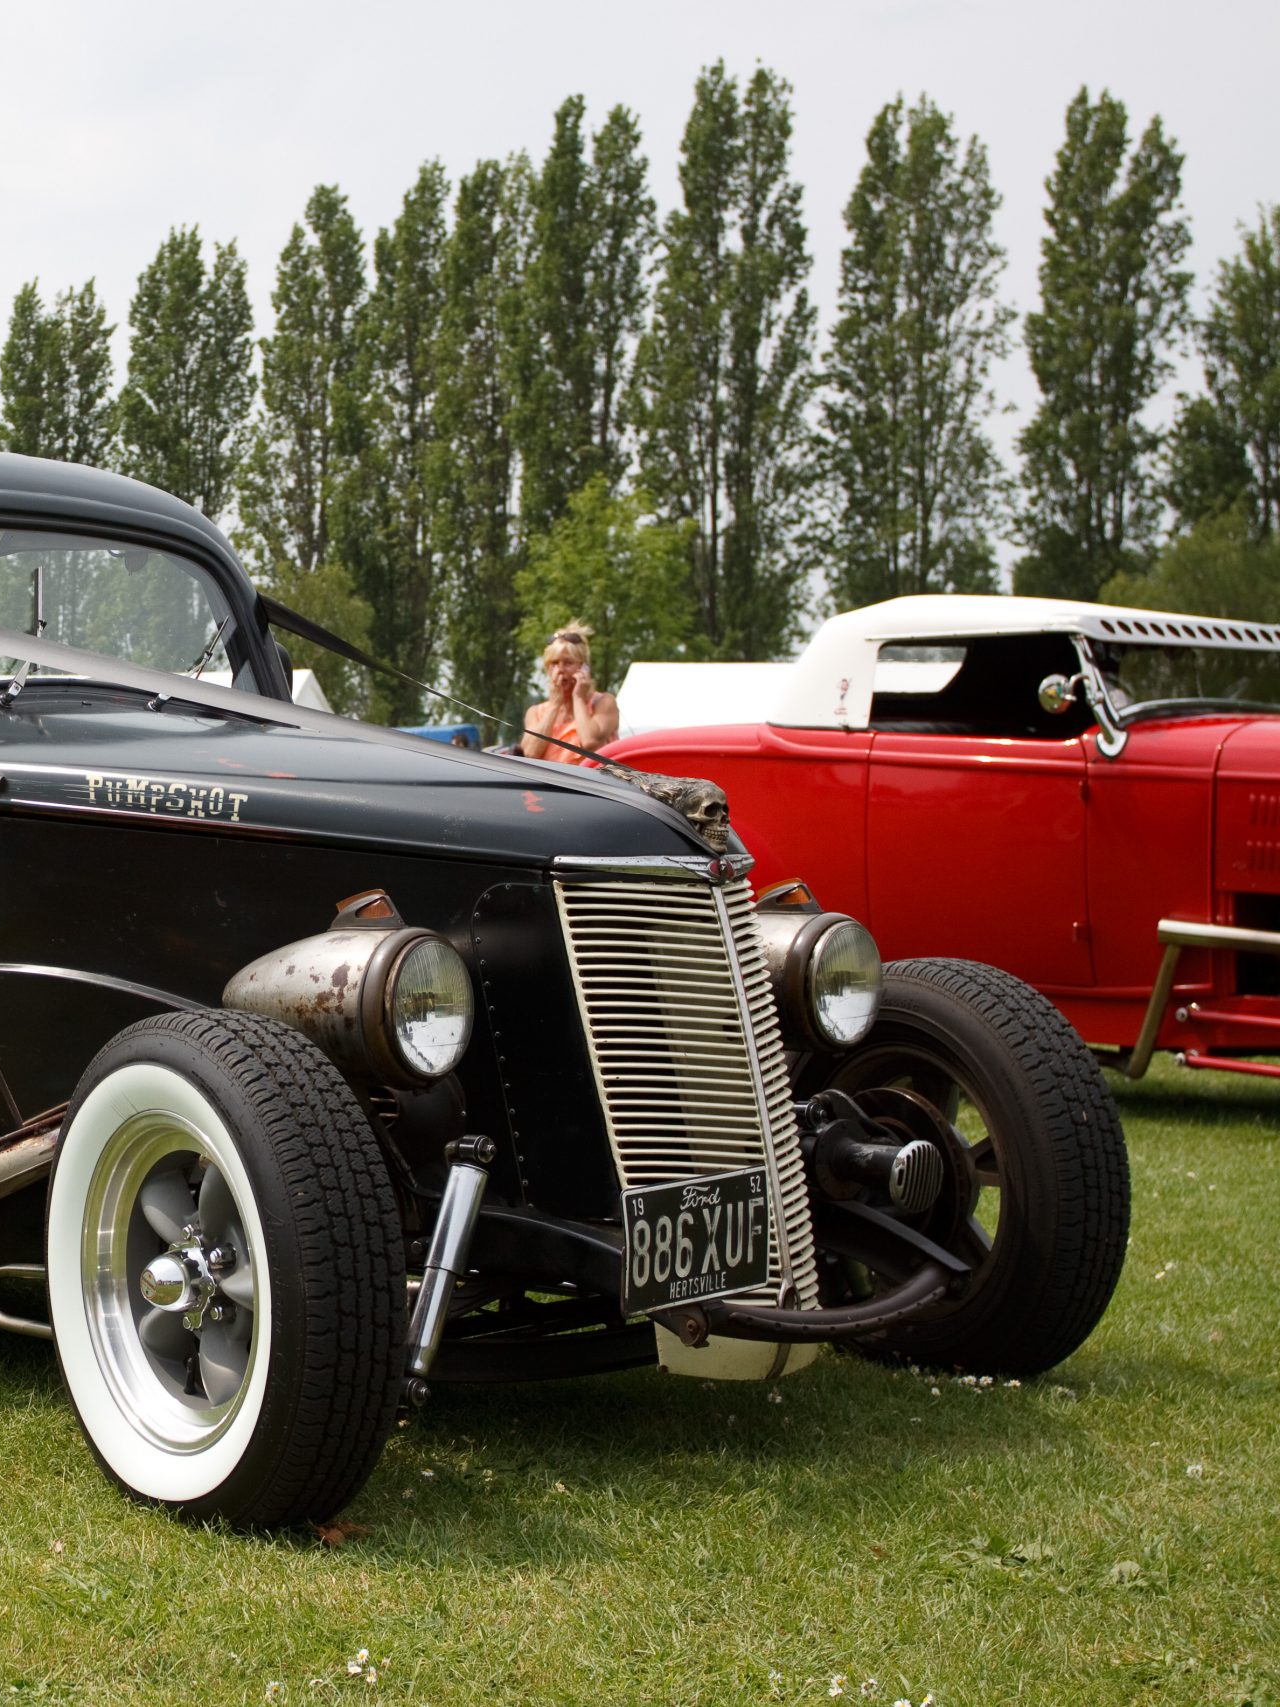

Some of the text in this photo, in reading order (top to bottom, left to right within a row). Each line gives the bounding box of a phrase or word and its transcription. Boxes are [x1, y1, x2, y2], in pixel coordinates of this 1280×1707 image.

[85, 774, 248, 821] PUMPSHOT
[680, 1185, 722, 1210] Ford
[750, 1175, 762, 1194] 52
[632, 1198, 645, 1217] 19
[632, 1197, 764, 1288] 886 XUF
[670, 1271, 727, 1299] HERTSVILLE
